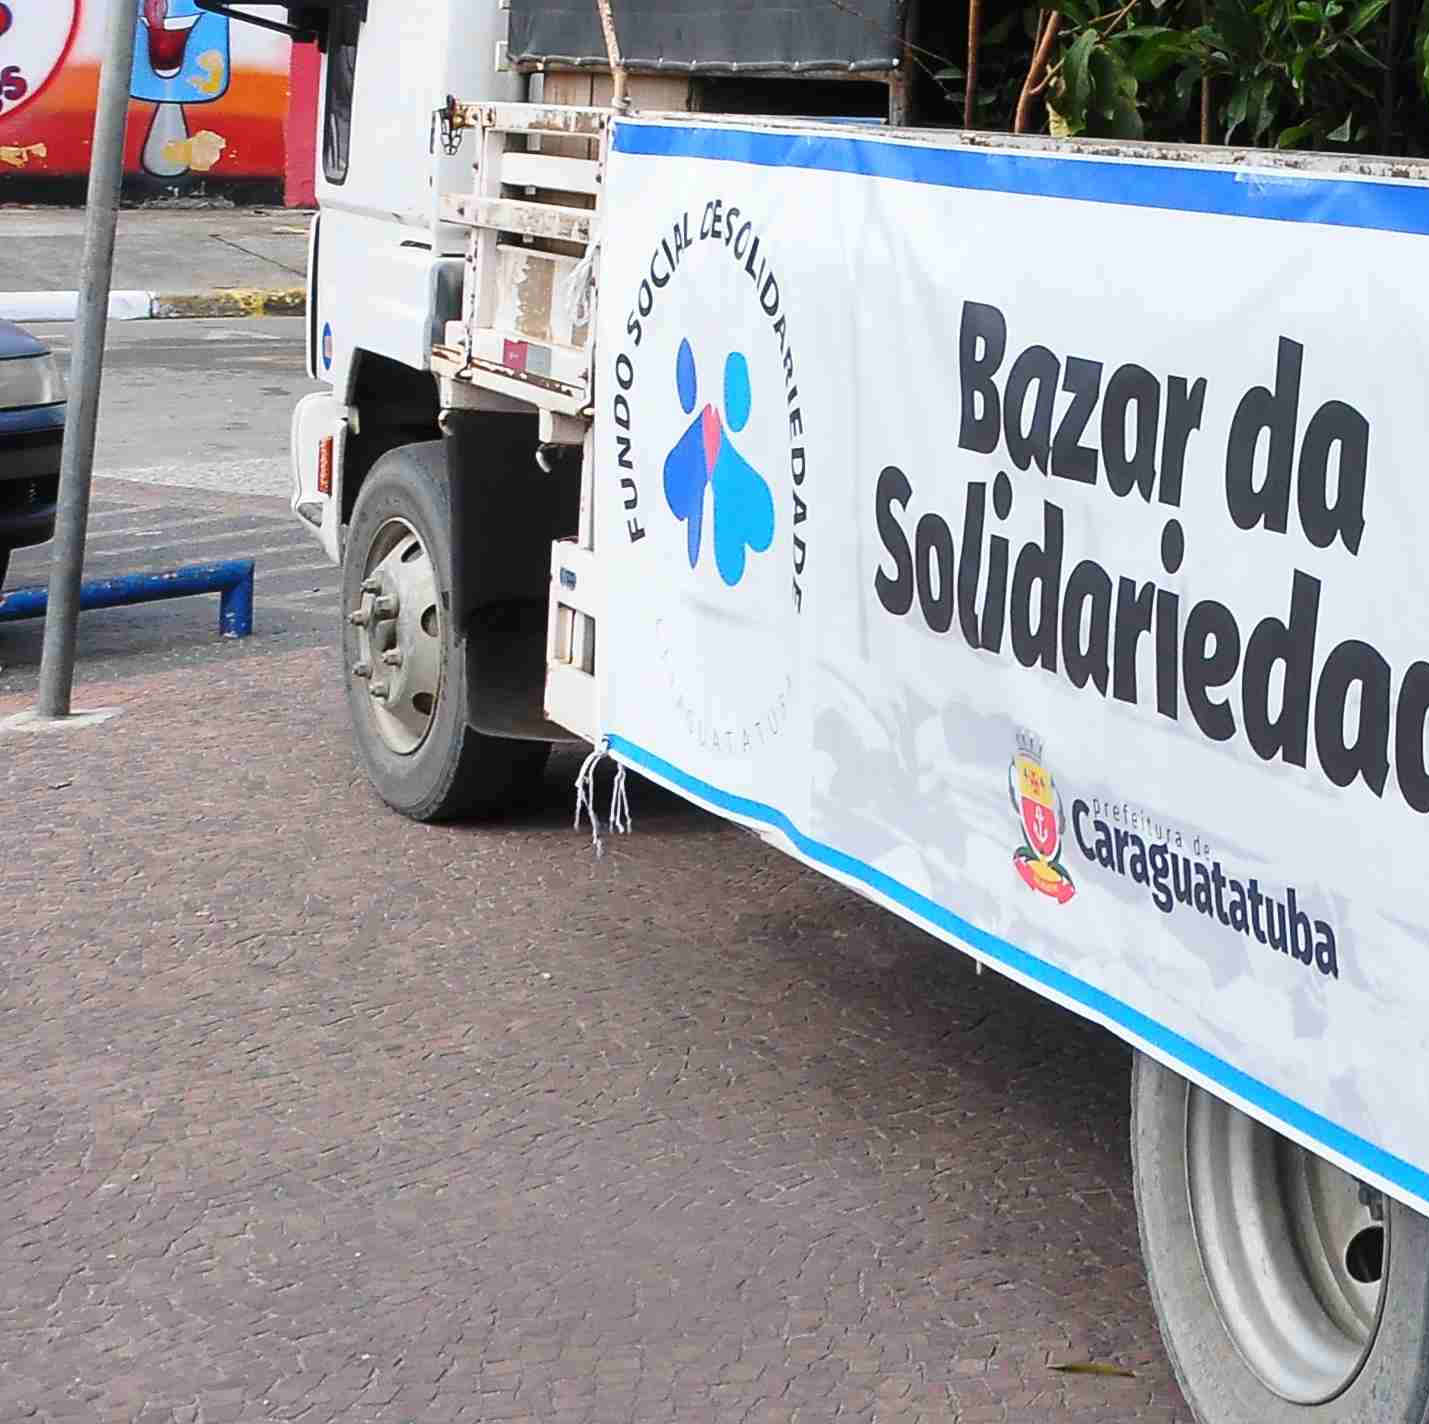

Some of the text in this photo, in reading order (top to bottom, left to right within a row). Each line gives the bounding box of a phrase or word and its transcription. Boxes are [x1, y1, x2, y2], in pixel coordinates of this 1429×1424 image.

[627, 212, 692, 346] SOCIAL
[615, 353, 645, 543] FUNDO
[958, 300, 1371, 556] Bazar da
[1072, 798, 1339, 980] Caraguatatuba
[1092, 798, 1210, 862] prefeitura de
